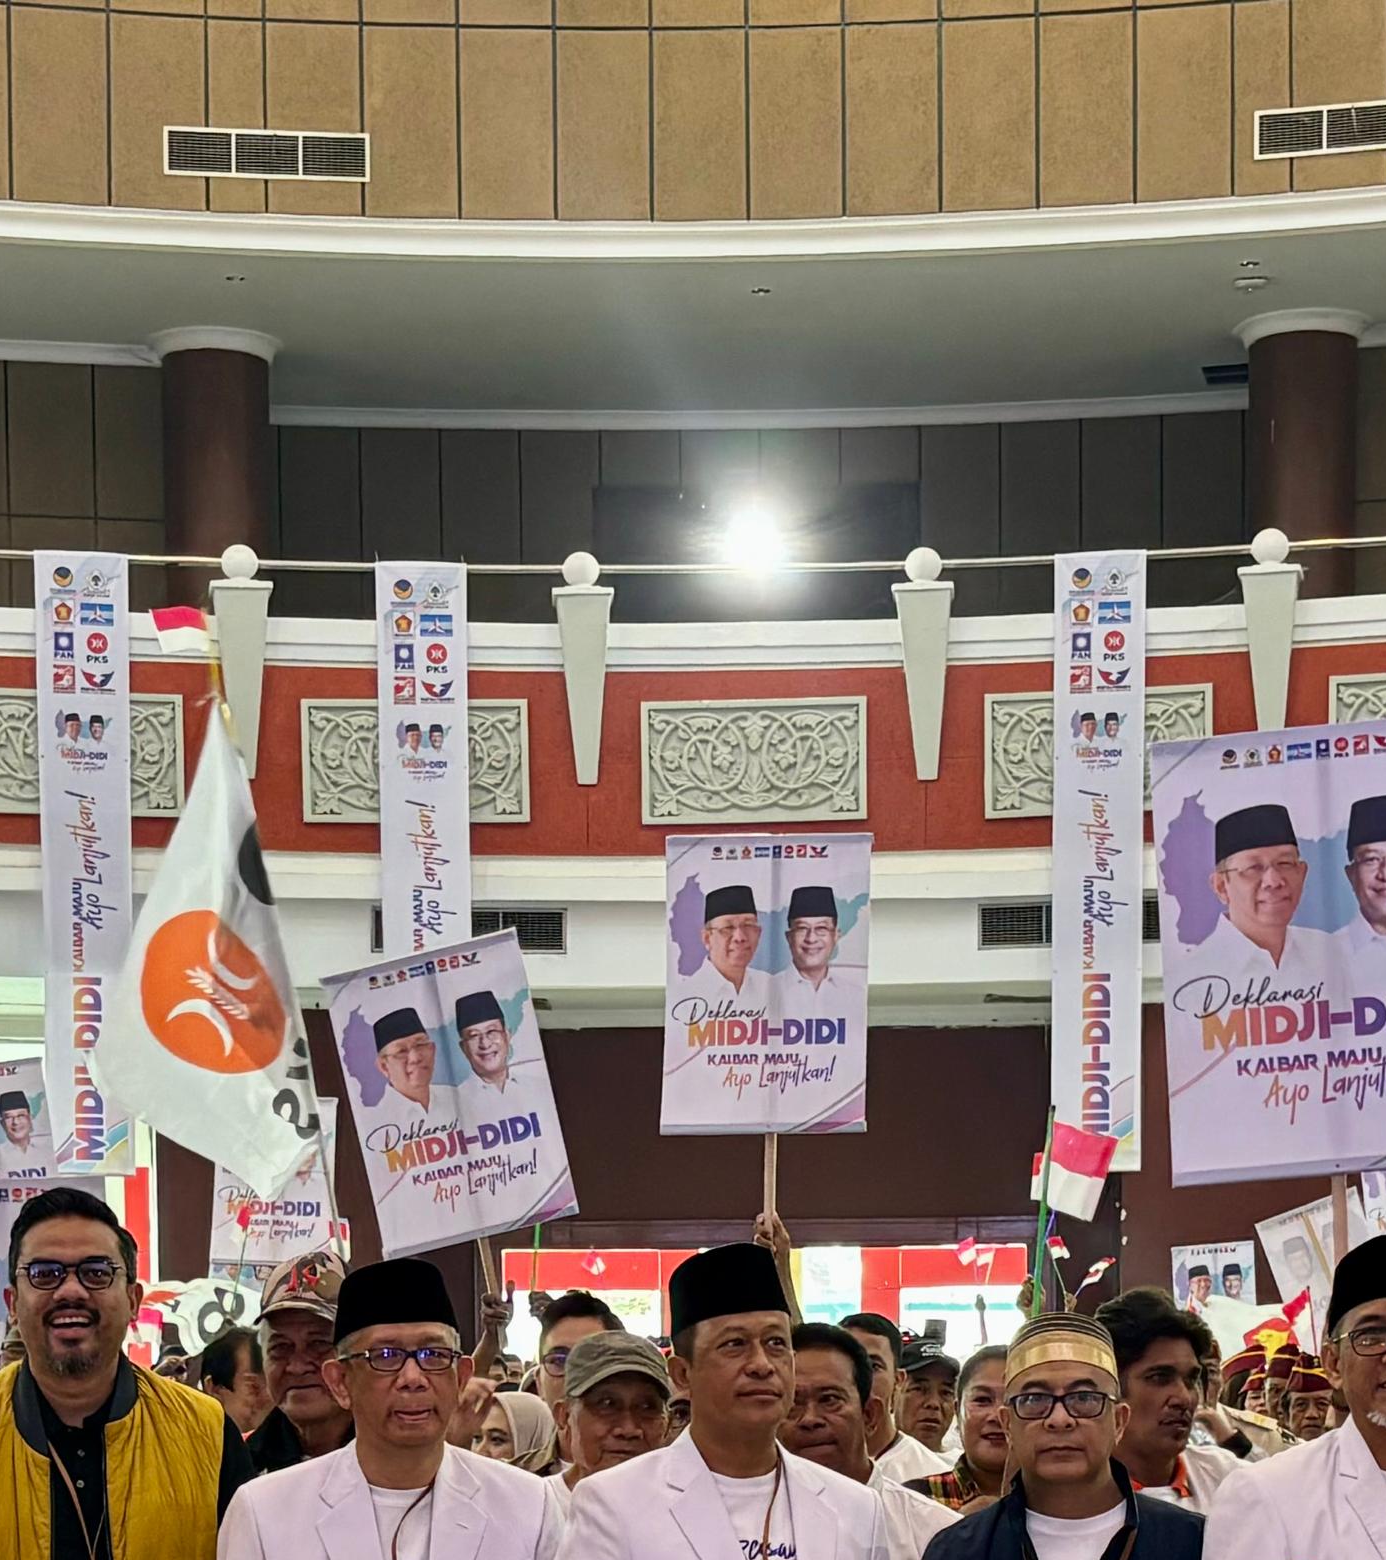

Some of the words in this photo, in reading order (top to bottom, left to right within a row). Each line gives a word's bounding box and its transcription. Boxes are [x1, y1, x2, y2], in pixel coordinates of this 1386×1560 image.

[54, 651, 74, 660] PAN
[86, 655, 108, 664] PKS
[426, 664, 448, 674] PKS
[1103, 652, 1125, 662] PKS
[65, 790, 111, 885] Lanjutkan!
[405, 800, 451, 890] Lanjutkan!
[1078, 789, 1122, 880] Lanjutkan!
[72, 878, 84, 921] MAJU
[83, 893, 118, 930] Ayo
[412, 886, 424, 926] MAJU
[421, 899, 457, 935] Ayo
[1083, 879, 1095, 921] MAJU
[1093, 889, 1129, 927] Ayo
[1173, 975, 1324, 1018] Deklarasi
[687, 1018, 846, 1047] MIDJI-DIDI
[707, 1053, 759, 1066] KALBAR
[764, 1052, 800, 1065] MAJU
[722, 1065, 751, 1100] Ayo
[759, 1055, 837, 1094] Lanjutkan!
[1237, 1054, 1319, 1077] KALBAR
[1326, 1046, 1383, 1068] MAJU
[1264, 1075, 1309, 1125] Ayo
[386, 1112, 541, 1173] MIDJI-DIDI
[433, 1181, 461, 1213] Ayo
[468, 1148, 537, 1195] Lanjutkan!
